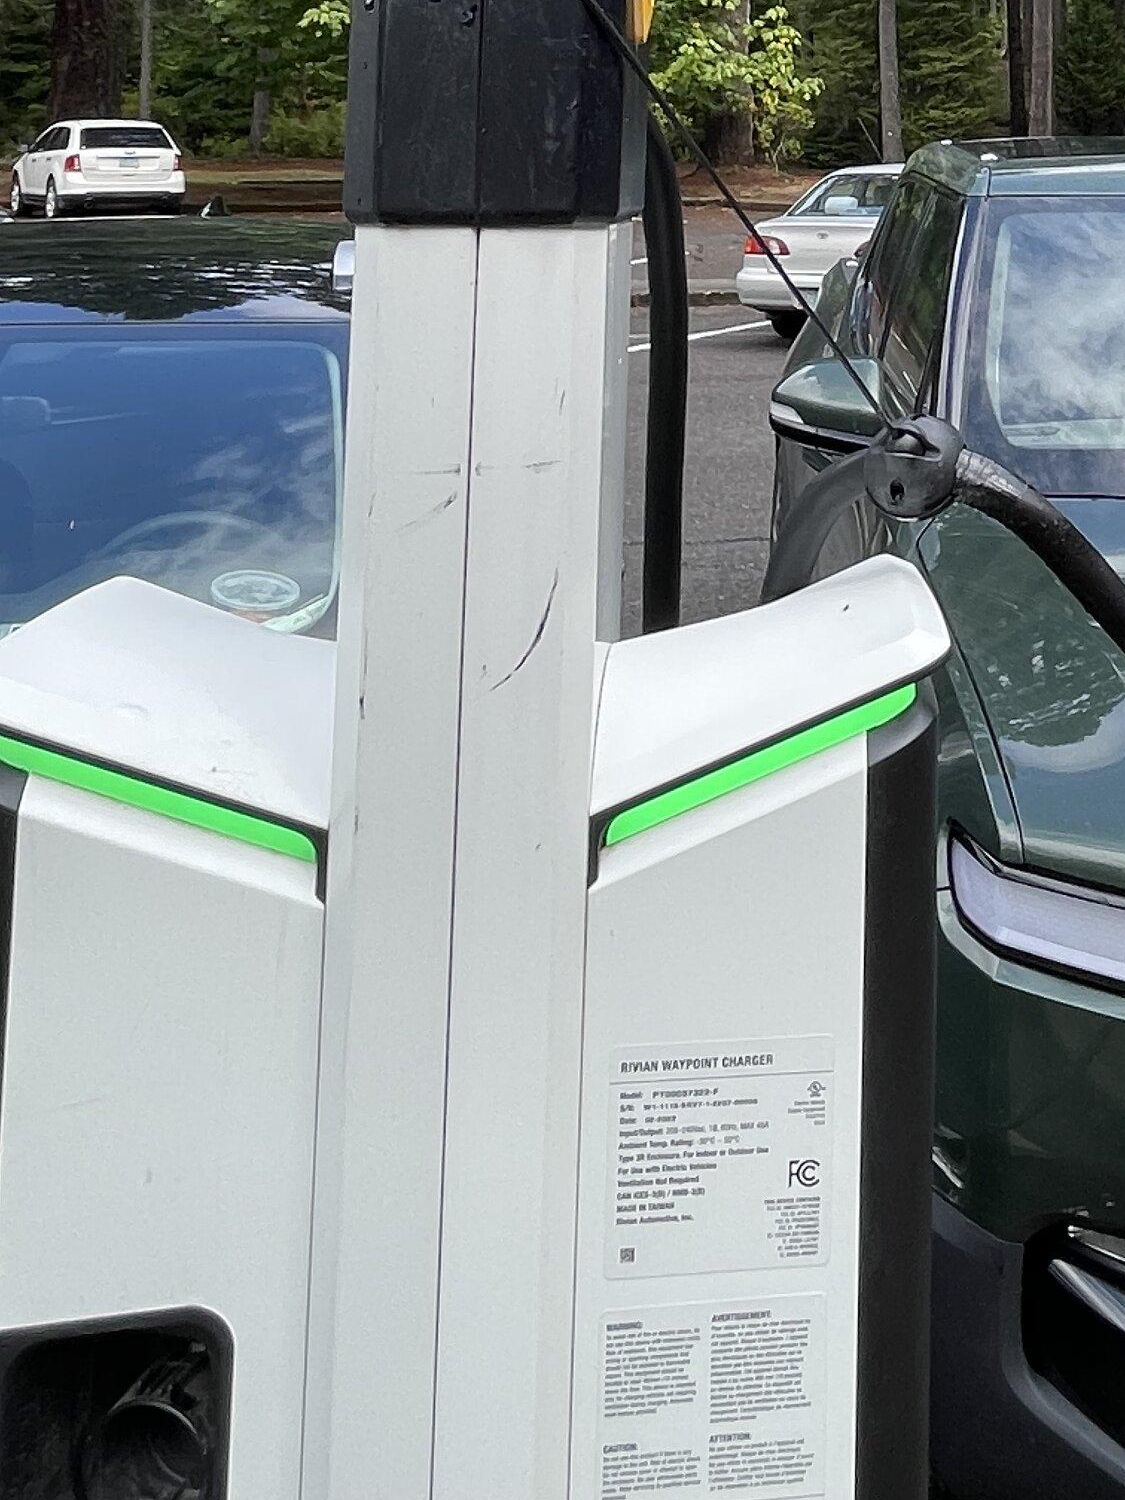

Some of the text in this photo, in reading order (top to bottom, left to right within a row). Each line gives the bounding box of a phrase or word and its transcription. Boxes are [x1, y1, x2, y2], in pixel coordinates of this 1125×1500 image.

[620, 1054, 774, 1073] RIVIAN WAYPOINT CHARGER
